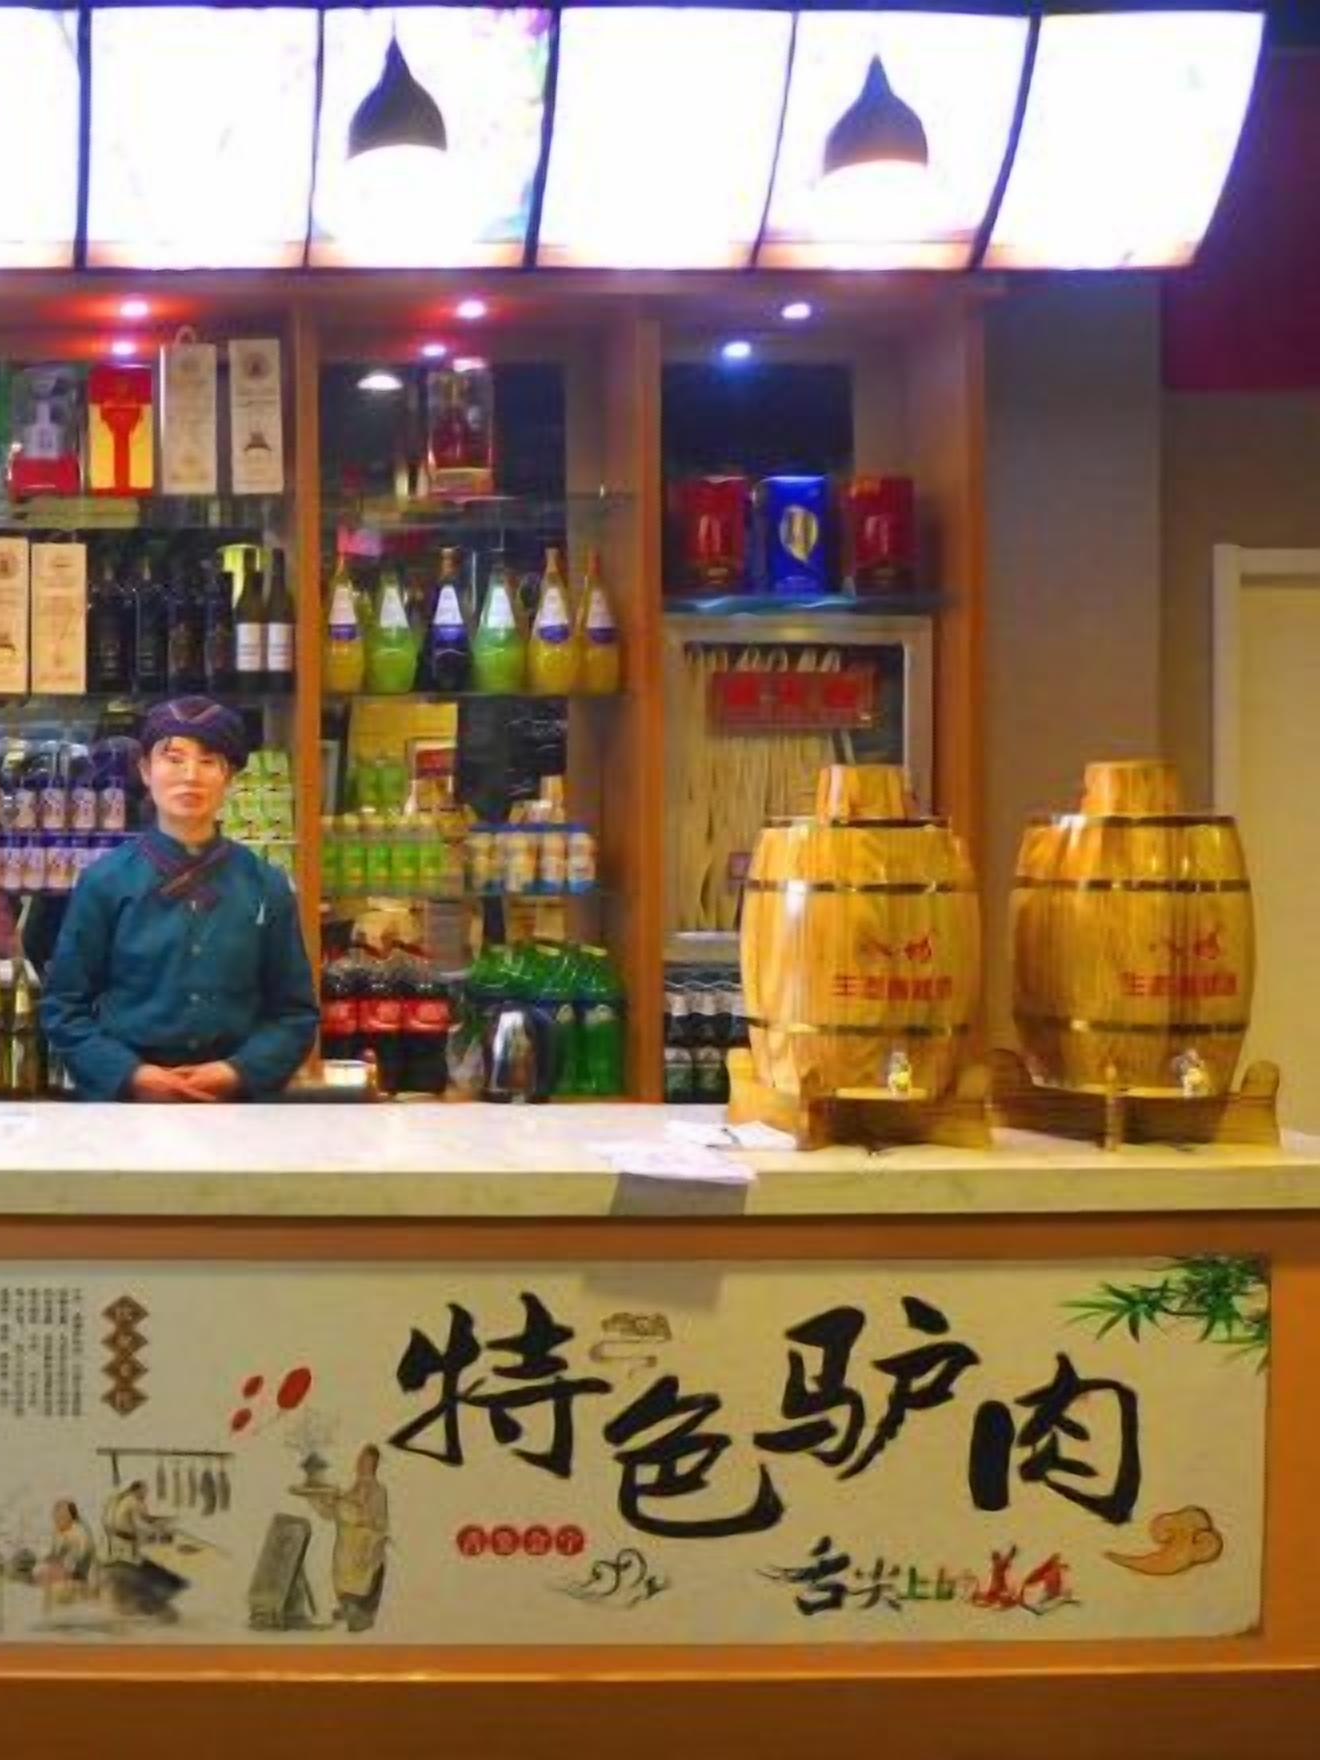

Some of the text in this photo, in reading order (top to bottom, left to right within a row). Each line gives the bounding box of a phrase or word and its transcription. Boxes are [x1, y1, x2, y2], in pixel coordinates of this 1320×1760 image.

[386, 1290, 1143, 1539] 特色驴肉
[755, 1535, 1082, 1617] 舌尖上的美食
